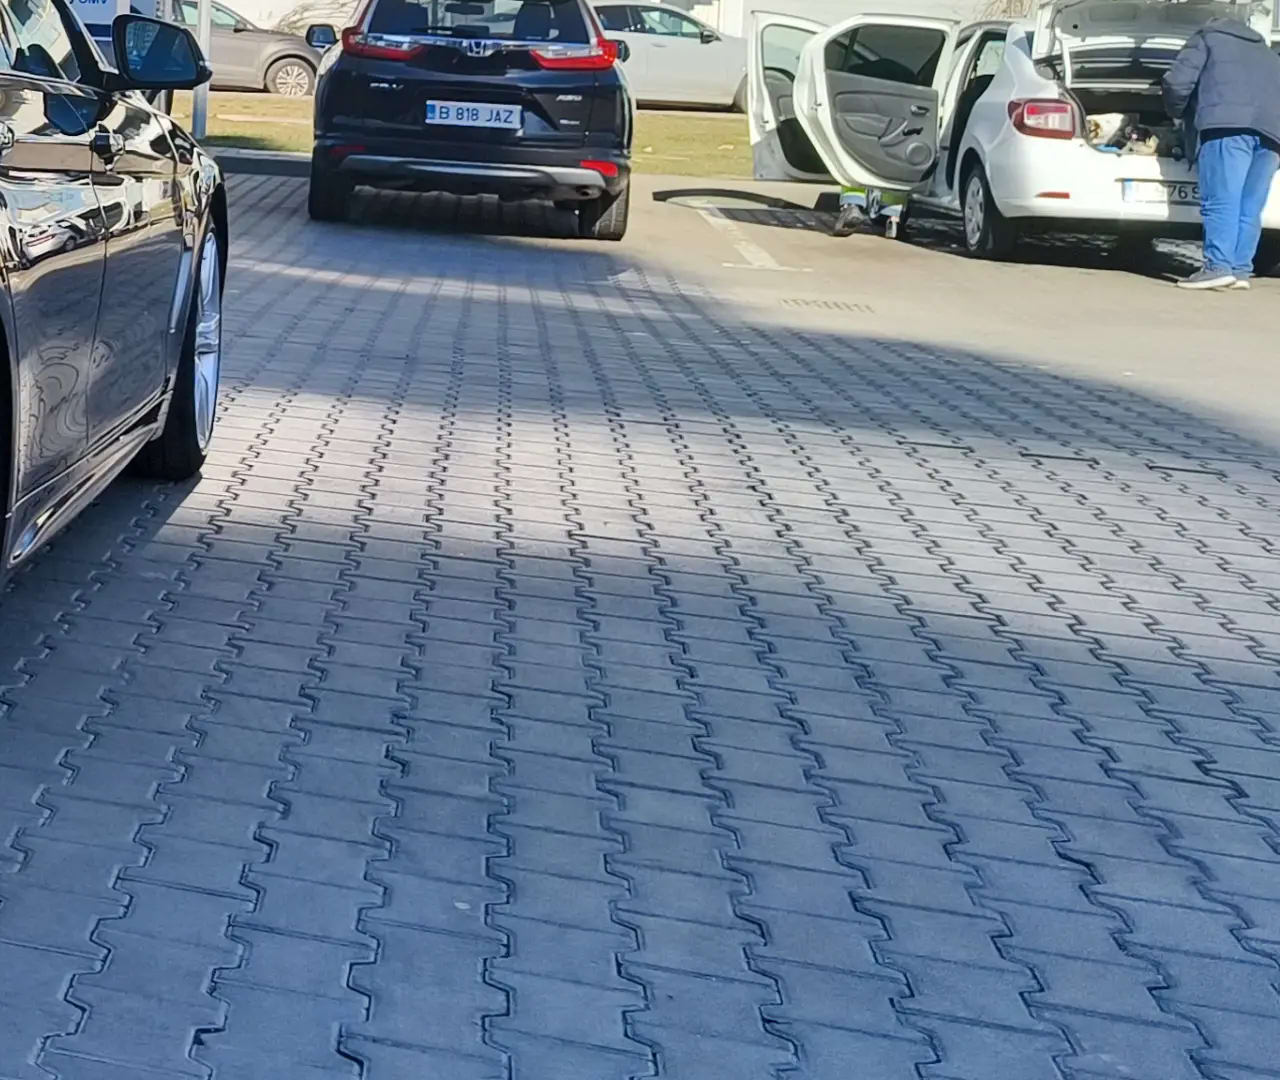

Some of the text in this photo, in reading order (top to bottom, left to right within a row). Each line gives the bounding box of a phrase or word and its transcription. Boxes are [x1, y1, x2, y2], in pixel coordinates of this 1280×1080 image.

[439, 106, 514, 125] B 818 JAZ
